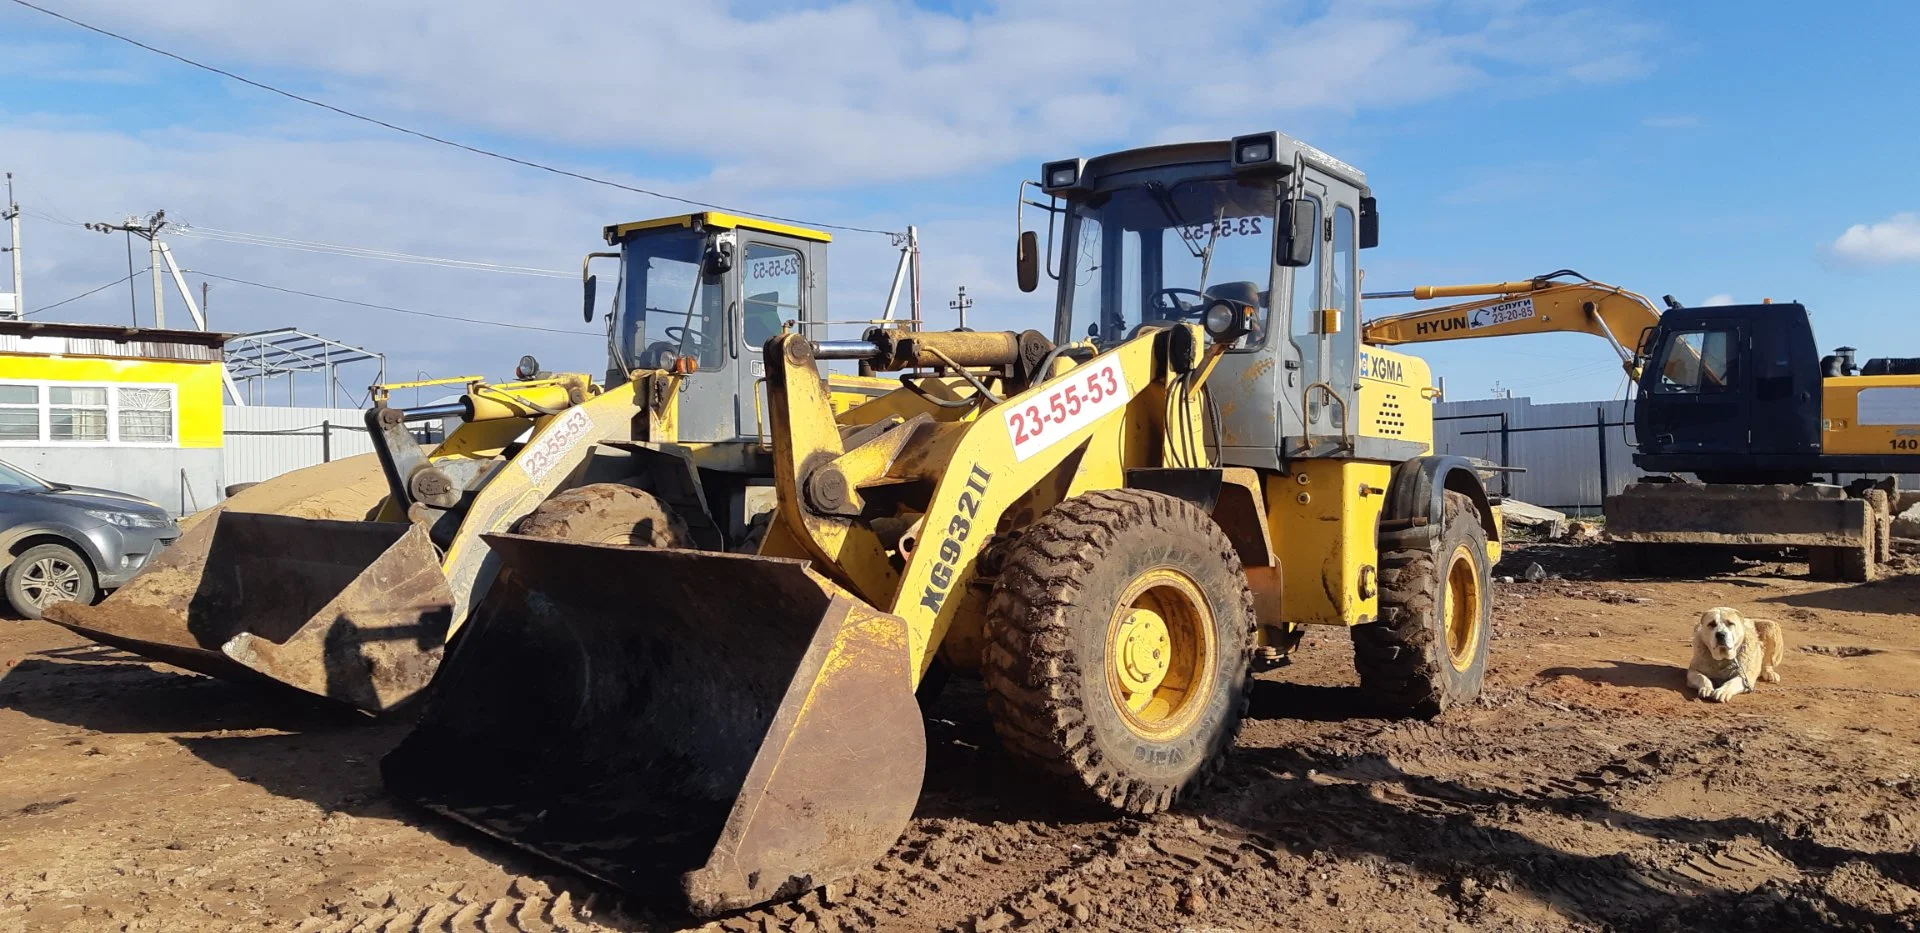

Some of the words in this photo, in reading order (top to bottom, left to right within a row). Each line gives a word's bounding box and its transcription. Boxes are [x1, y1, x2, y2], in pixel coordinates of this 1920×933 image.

[1492, 299, 1531, 313] УСЛУГИ
[1492, 306, 1533, 324] 23-20-85
[1416, 316, 1470, 335] HYUN
[1371, 355, 1404, 383] XGMA
[1009, 366, 1118, 447] 23-55-53
[525, 412, 587, 476] 23-55-53
[1888, 439, 1919, 451] 140
